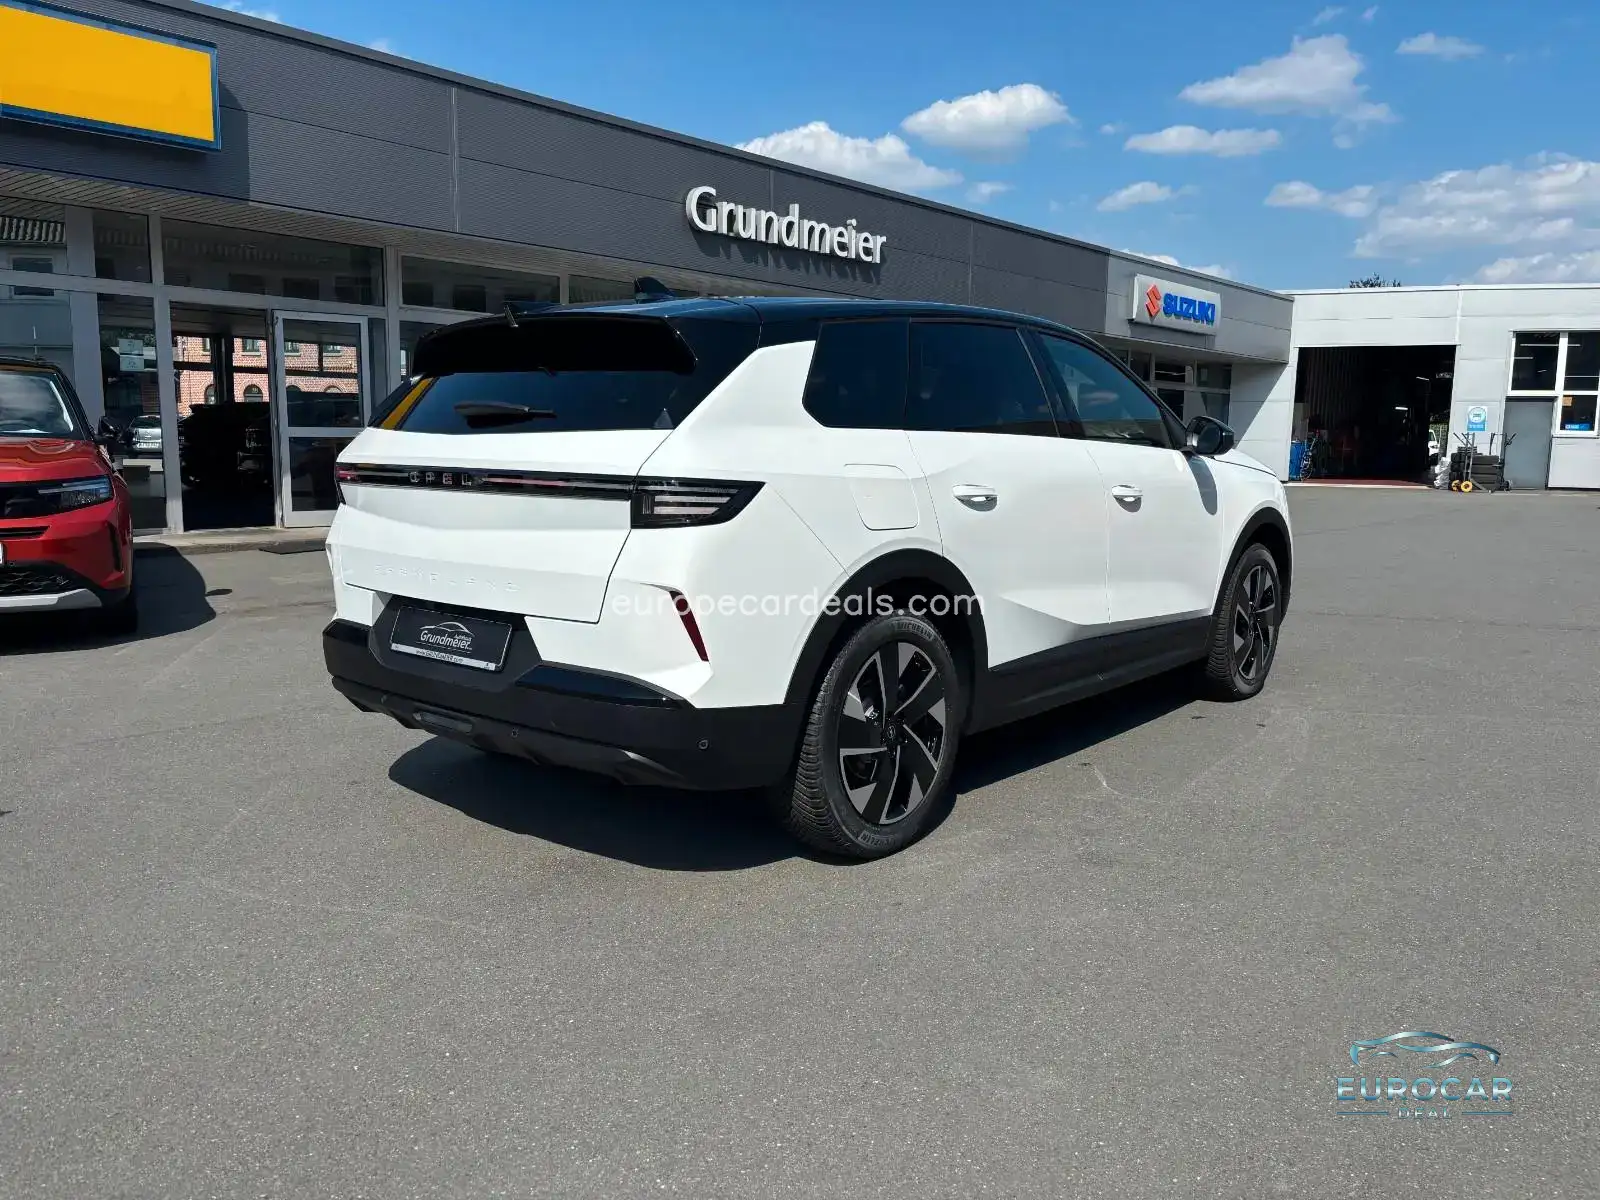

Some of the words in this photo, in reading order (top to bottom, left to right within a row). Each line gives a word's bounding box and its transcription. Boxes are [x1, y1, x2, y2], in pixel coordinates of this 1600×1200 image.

[685, 185, 887, 264] Grundmeier
[1163, 293, 1216, 326] SUZUKI
[409, 471, 472, 486] OPEL
[420, 630, 472, 651] Grundmeier
